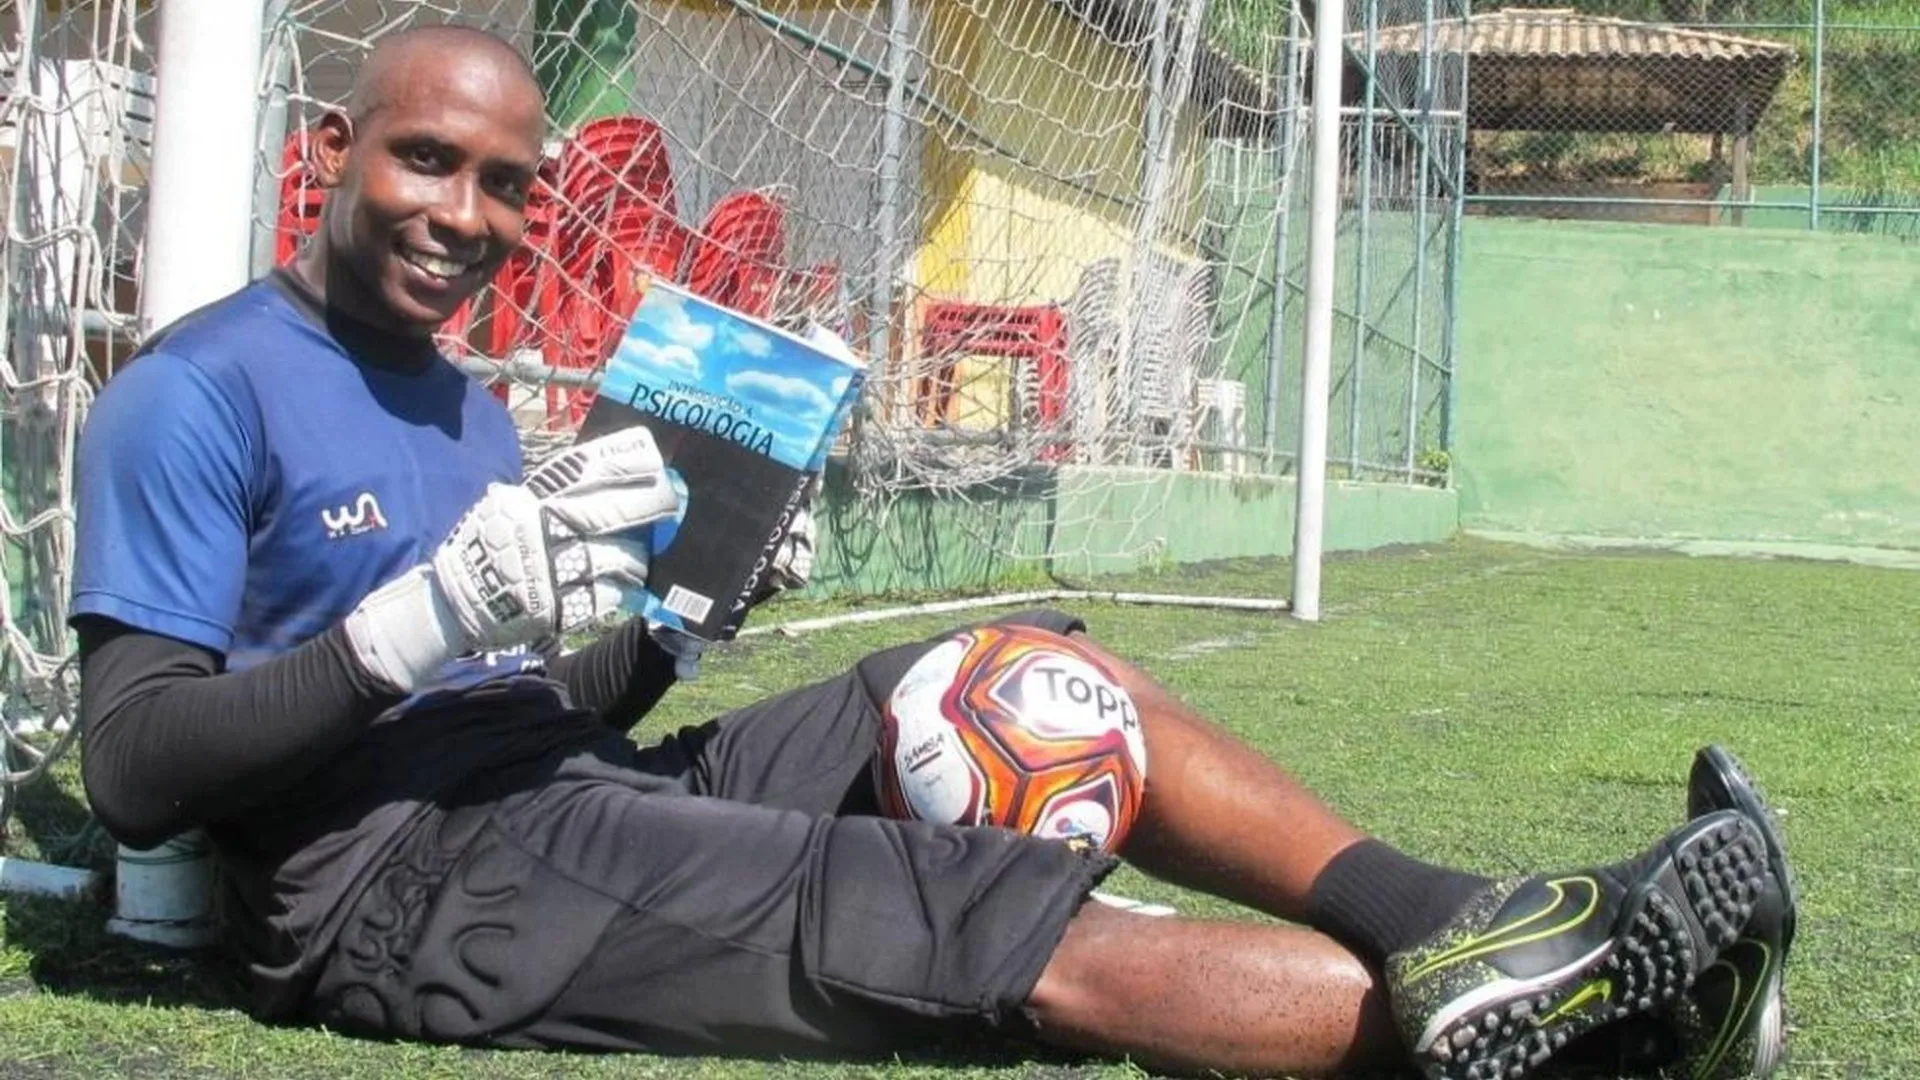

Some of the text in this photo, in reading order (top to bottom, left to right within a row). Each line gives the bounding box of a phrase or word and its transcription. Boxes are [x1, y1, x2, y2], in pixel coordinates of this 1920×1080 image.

[628, 383, 774, 456] PSICOLOGIA
[730, 475, 810, 612] PSICOLOGIA
[904, 732, 945, 767] SAMBA
